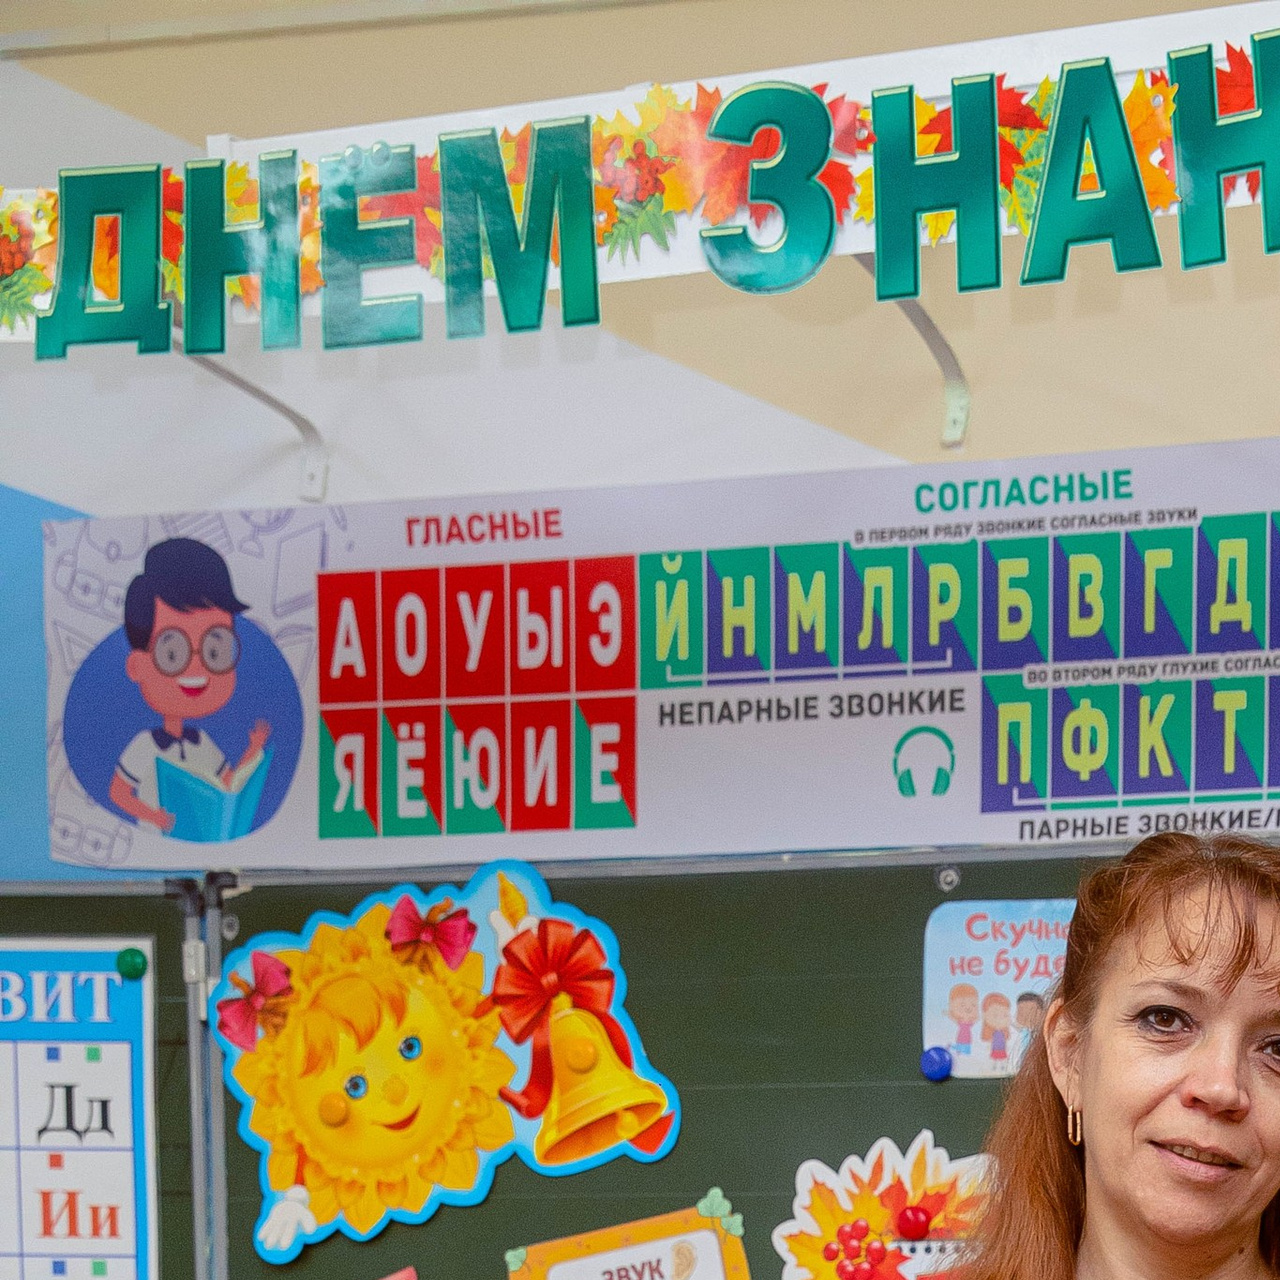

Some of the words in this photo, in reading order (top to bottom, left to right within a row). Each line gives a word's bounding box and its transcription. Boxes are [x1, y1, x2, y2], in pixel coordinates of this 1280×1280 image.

[915, 469, 1133, 514] СОГЛАСНЫЕ
[406, 508, 563, 547] ГЛАСНЫЕ
[934, 522, 972, 539] РЯДУ
[977, 518, 1046, 536] ЗВОНКИЕ
[1050, 511, 1142, 532] СОГЛАСНЫЕ
[1146, 508, 1198, 525] ЗВУКИ
[1027, 670, 1048, 684] ВО
[1117, 663, 1158, 680] РЯДУ
[1162, 660, 1220, 677] ГЛУХИЕ
[658, 695, 819, 727] НЕПАРНЫЕ
[828, 687, 966, 719] ЗВОНКИЕ
[1018, 809, 1129, 841] ПАРНЫЕ
[949, 955, 984, 977] не
